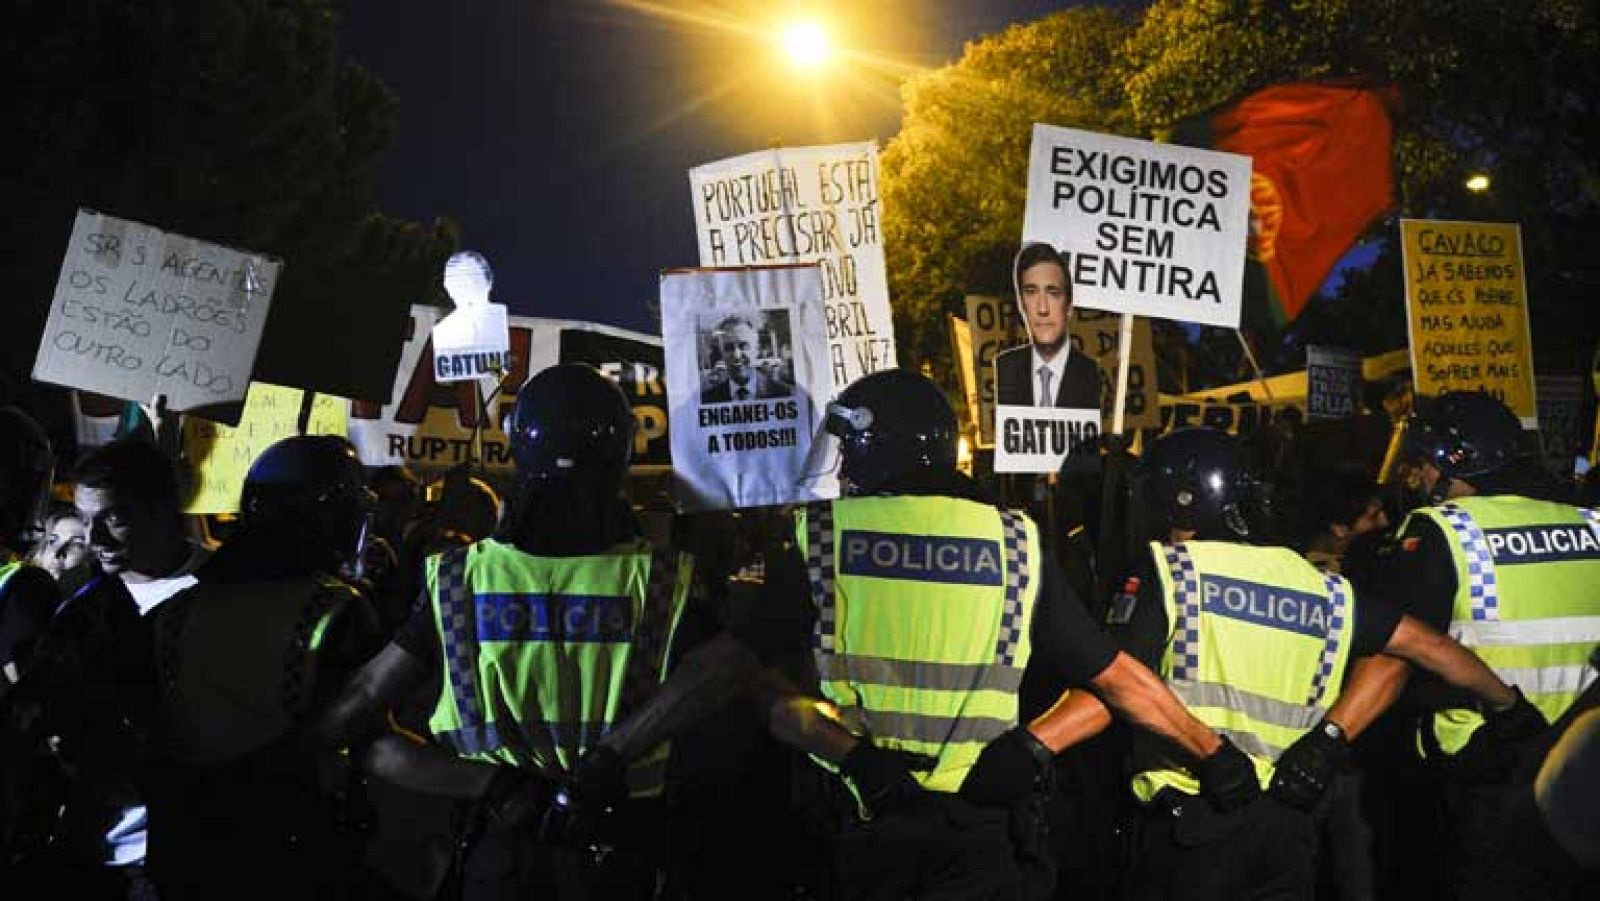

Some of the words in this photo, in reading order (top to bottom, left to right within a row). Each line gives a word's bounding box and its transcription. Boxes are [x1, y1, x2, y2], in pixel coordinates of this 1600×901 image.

[701, 167, 807, 224] PORTUGAL
[818, 151, 873, 206] ESTÁ
[1050, 146, 1228, 199] EXIGIMOS
[1052, 181, 1221, 232] POLÍTICA
[709, 228, 726, 264] A
[734, 210, 842, 263] PRECISAR
[847, 199, 878, 249] JÁ
[1096, 222, 1174, 260] SEM
[1418, 229, 1504, 255] CAVACO
[70, 270, 107, 294] OS
[172, 328, 211, 351] DO
[53, 331, 143, 370] OUTRO
[155, 354, 232, 394] LADO
[699, 400, 799, 429] ENGANEI-OS
[708, 434, 720, 454] A
[723, 426, 797, 452] TODOS!!!
[847, 538, 999, 575] POLICIA
[1486, 529, 1598, 558] POLICIA
[1203, 581, 1326, 631] POLICIA
